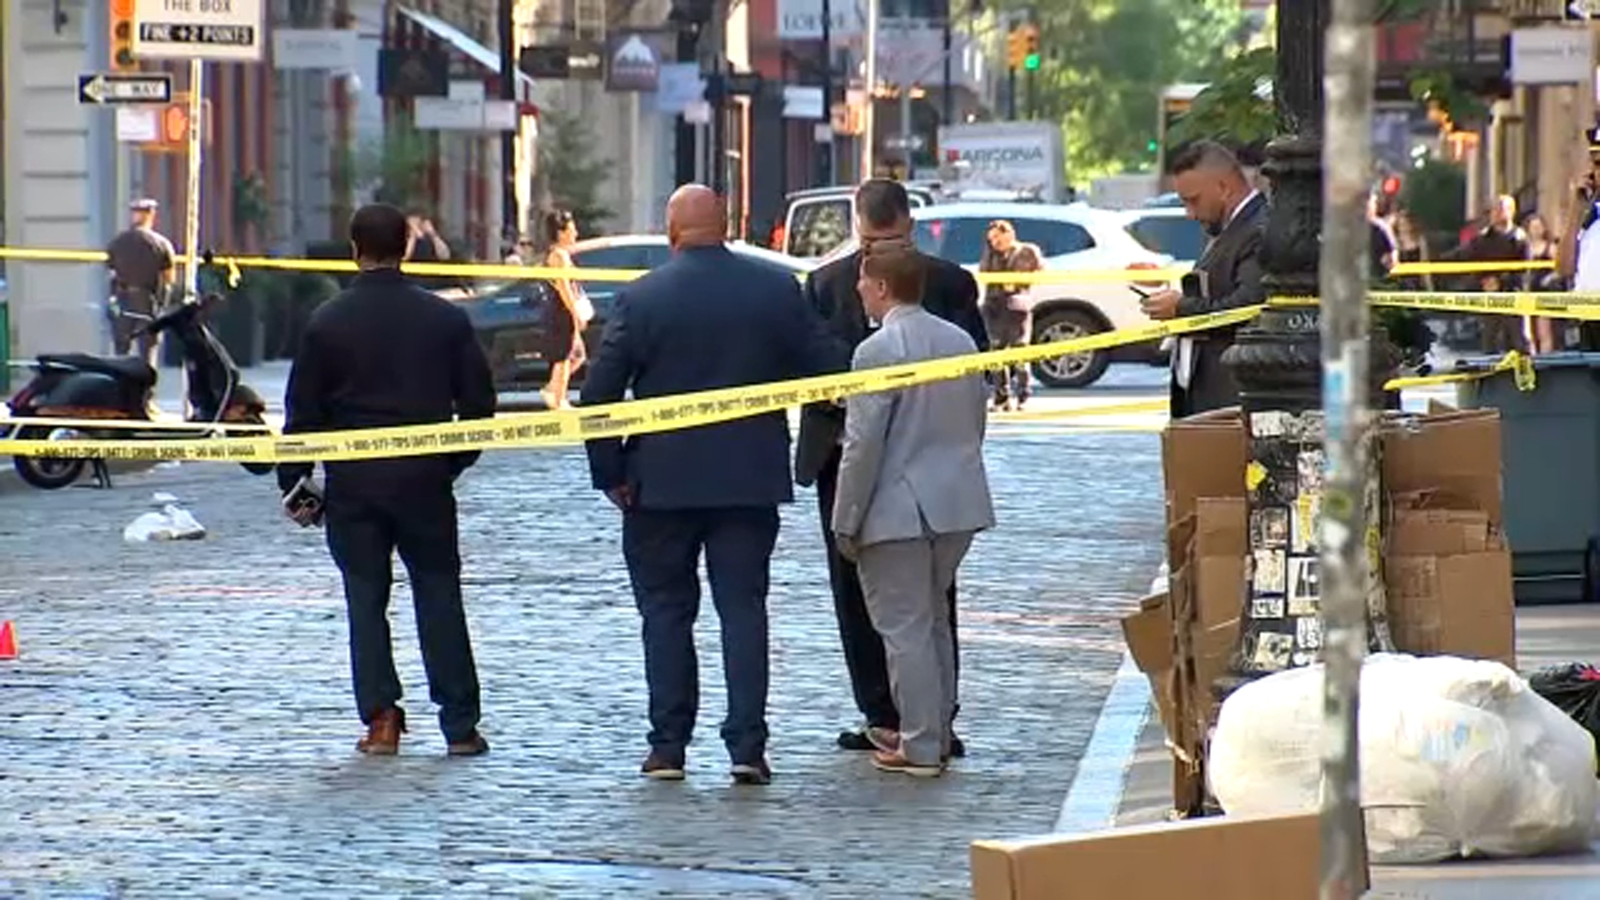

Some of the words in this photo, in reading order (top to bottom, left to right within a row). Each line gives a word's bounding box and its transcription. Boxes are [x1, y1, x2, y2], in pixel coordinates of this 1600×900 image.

[163, 0, 191, 11] THE
[199, 0, 231, 12] BOX
[143, 24, 172, 40] FINE
[202, 26, 250, 44] POINTS
[91, 82, 117, 96] ONE
[130, 82, 160, 96] WAY
[440, 431, 466, 445] CRIME
[467, 430, 494, 443] SCENE
[503, 427, 515, 440] DO
[517, 425, 532, 438] NOT
[534, 422, 562, 437] CROSS
